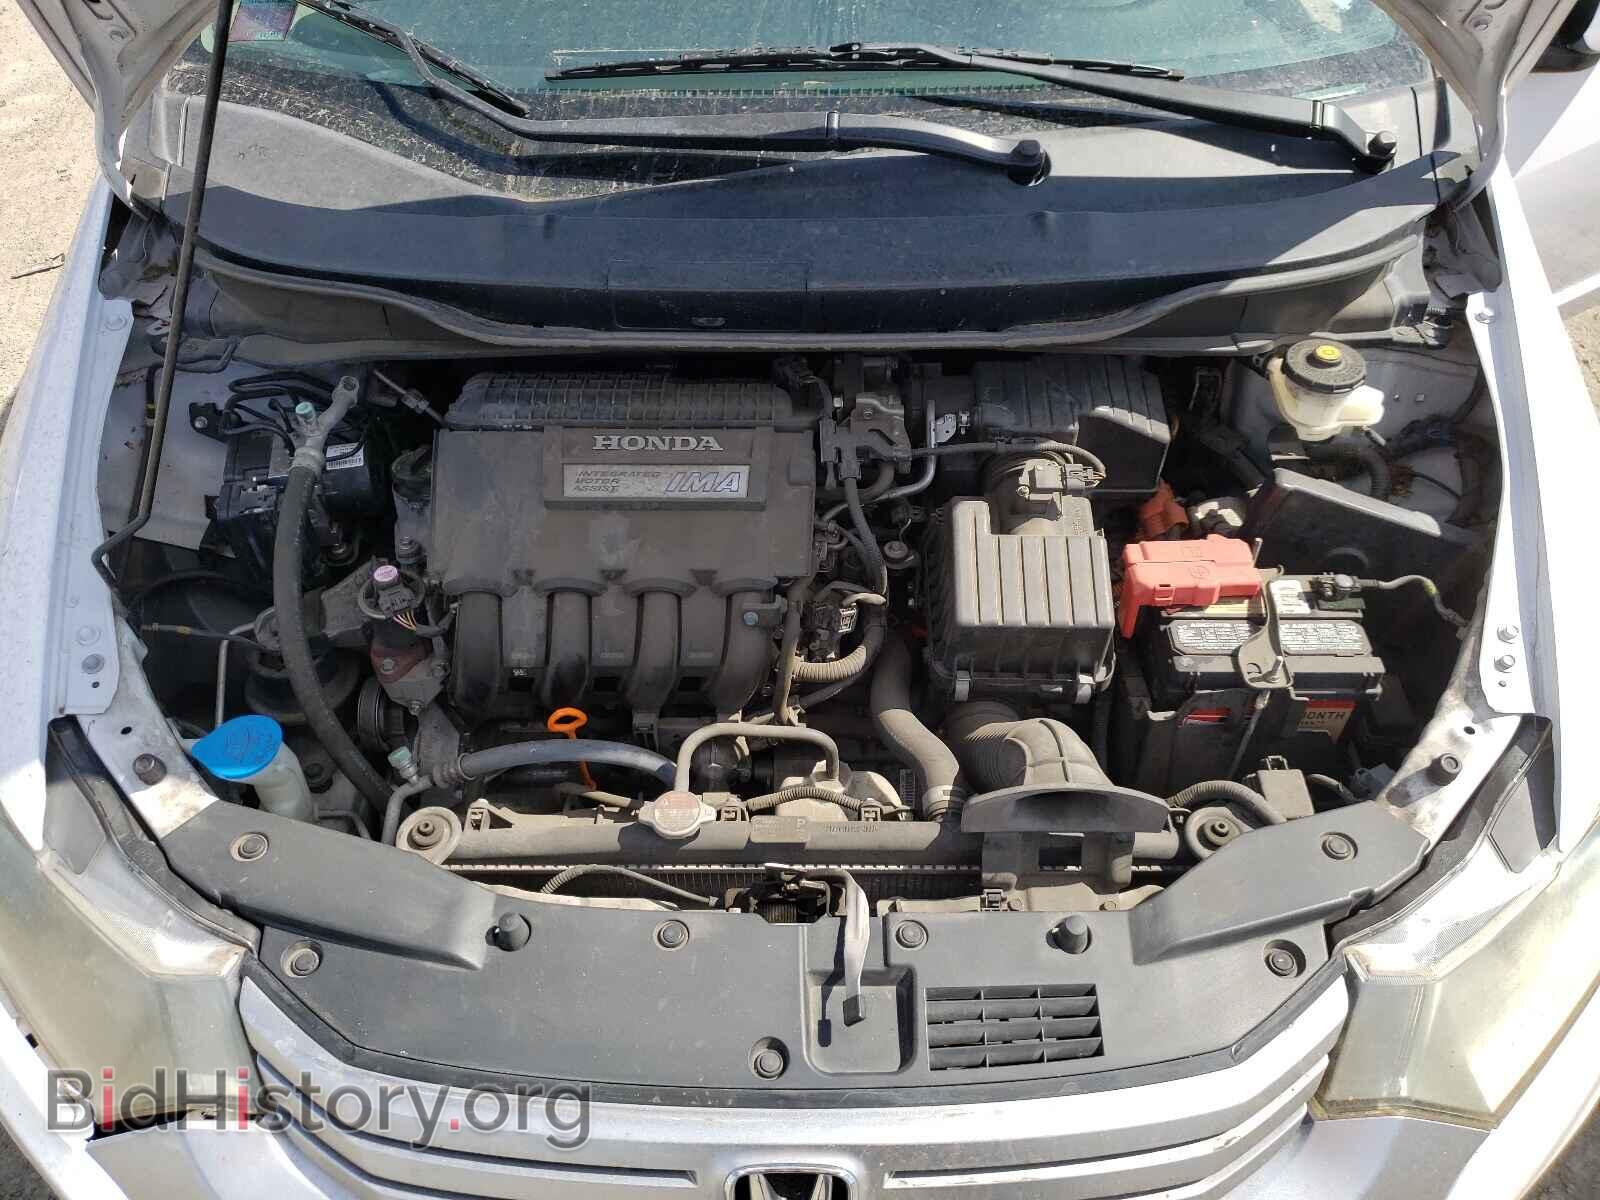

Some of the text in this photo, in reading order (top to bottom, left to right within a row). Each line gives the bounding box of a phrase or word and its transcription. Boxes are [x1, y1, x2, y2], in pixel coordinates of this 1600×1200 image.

[592, 435, 724, 451] HONDA
[577, 470, 663, 478] INTEGRATED
[665, 471, 741, 493] IMA
[573, 485, 620, 493] ASSIST
